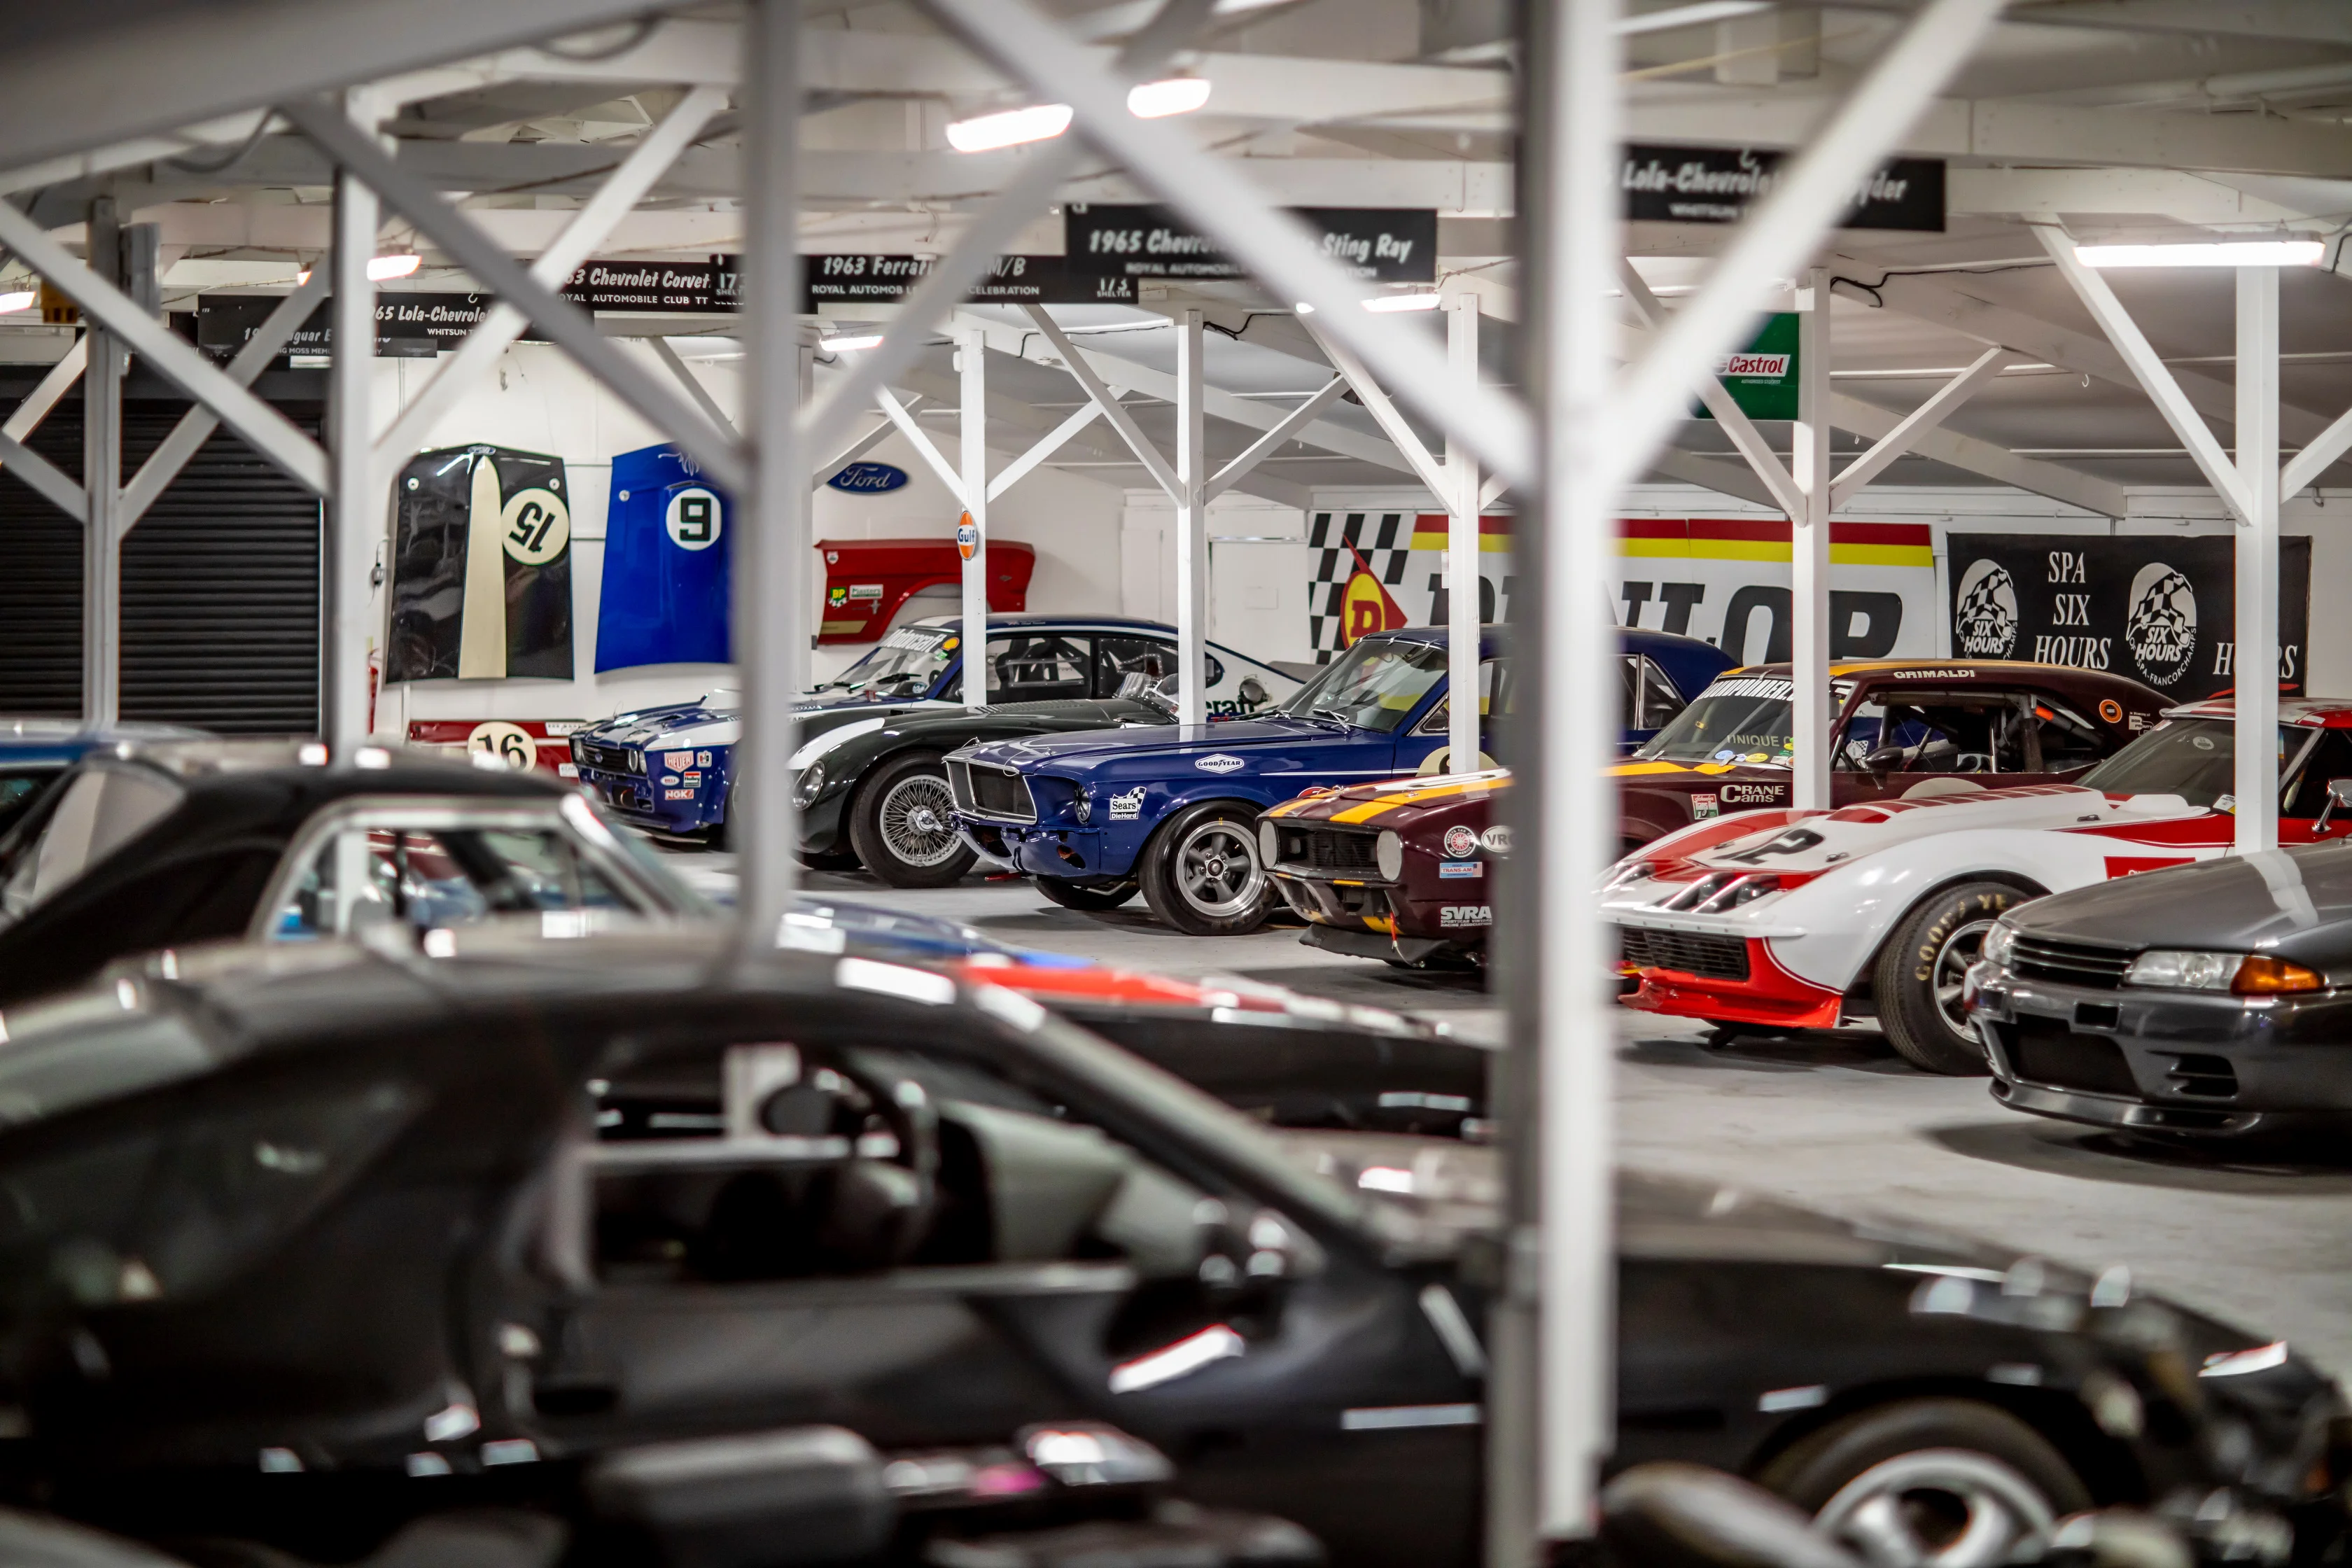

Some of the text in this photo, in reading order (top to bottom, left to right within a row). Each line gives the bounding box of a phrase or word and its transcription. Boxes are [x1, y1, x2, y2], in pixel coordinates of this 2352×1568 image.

[1621, 159, 1770, 194] Lola-Chevrole
[1089, 230, 1142, 253] 1965
[1322, 232, 1371, 263] Sting
[1375, 233, 1413, 264] Ray
[822, 255, 867, 275] 1963
[589, 267, 659, 288] Chevrolet
[662, 270, 711, 289] Corvet
[812, 284, 845, 295] ROYAL
[592, 294, 658, 304] AUTOMOBILE
[663, 295, 690, 305] CLUB
[695, 296, 708, 305] TT
[426, 328, 467, 336] WHITSUN
[1728, 356, 1784, 373] Castrol
[839, 465, 892, 489] Ford
[958, 528, 975, 542] Gulf
[2047, 551, 2086, 584] SPA
[832, 589, 846, 599] BP
[1350, 599, 1382, 638] D
[2052, 594, 2090, 626] SIX
[1972, 620, 1995, 637] SIX
[2145, 626, 2171, 644] SIX
[1963, 636, 2005, 654] HOURS
[2034, 635, 2112, 670] HOURS
[2129, 636, 2136, 652] OF
[2134, 643, 2183, 662] HOURS
[1893, 669, 1975, 679] GRIMALDI
[477, 733, 528, 771] 16
[1112, 801, 1136, 810] Sears
[1440, 906, 1492, 920] SVRA
